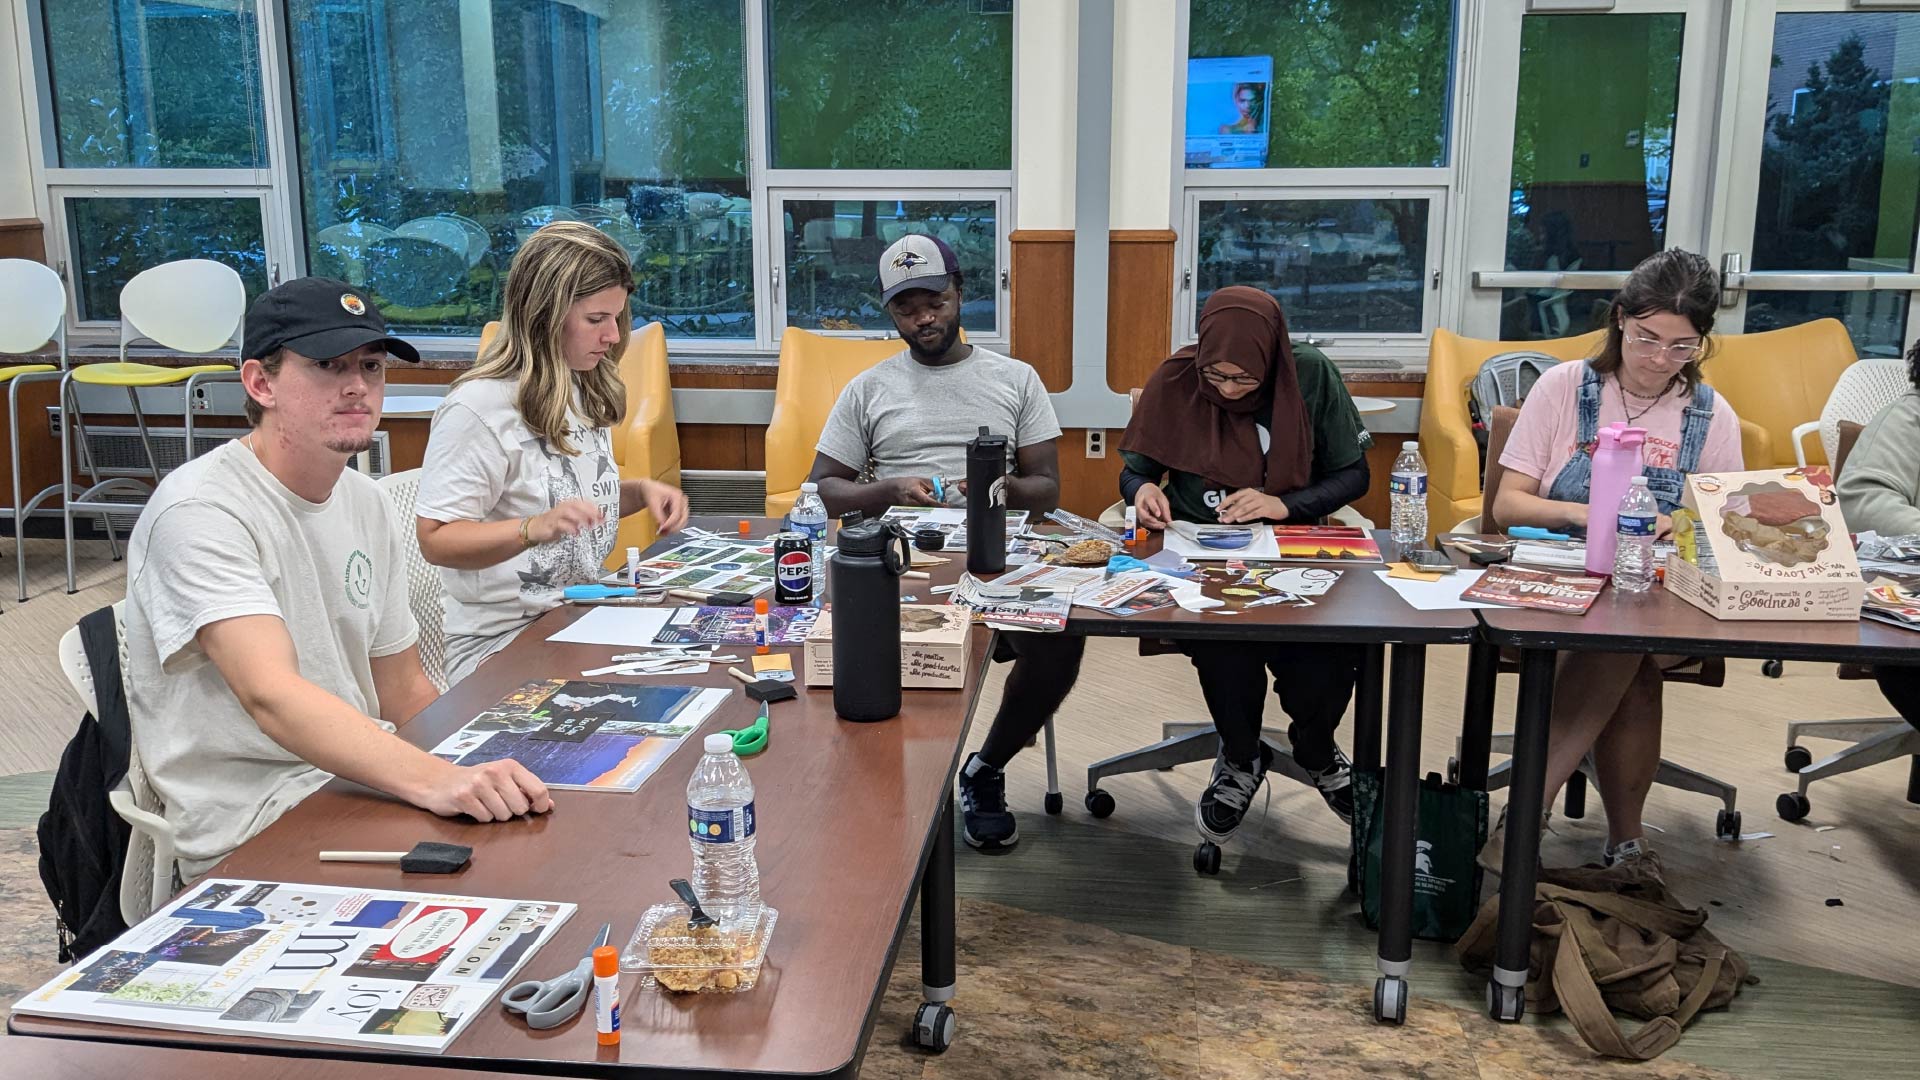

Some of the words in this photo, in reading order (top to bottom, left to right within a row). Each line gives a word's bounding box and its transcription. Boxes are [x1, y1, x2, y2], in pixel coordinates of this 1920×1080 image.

[1753, 562, 1772, 577] Pie
[1776, 569, 1807, 579] Love
[1807, 563, 1827, 575] We
[1738, 589, 1801, 611] Goodness
[278, 923, 297, 933] IN
[223, 966, 242, 981] OF
[327, 984, 403, 1023] joy
